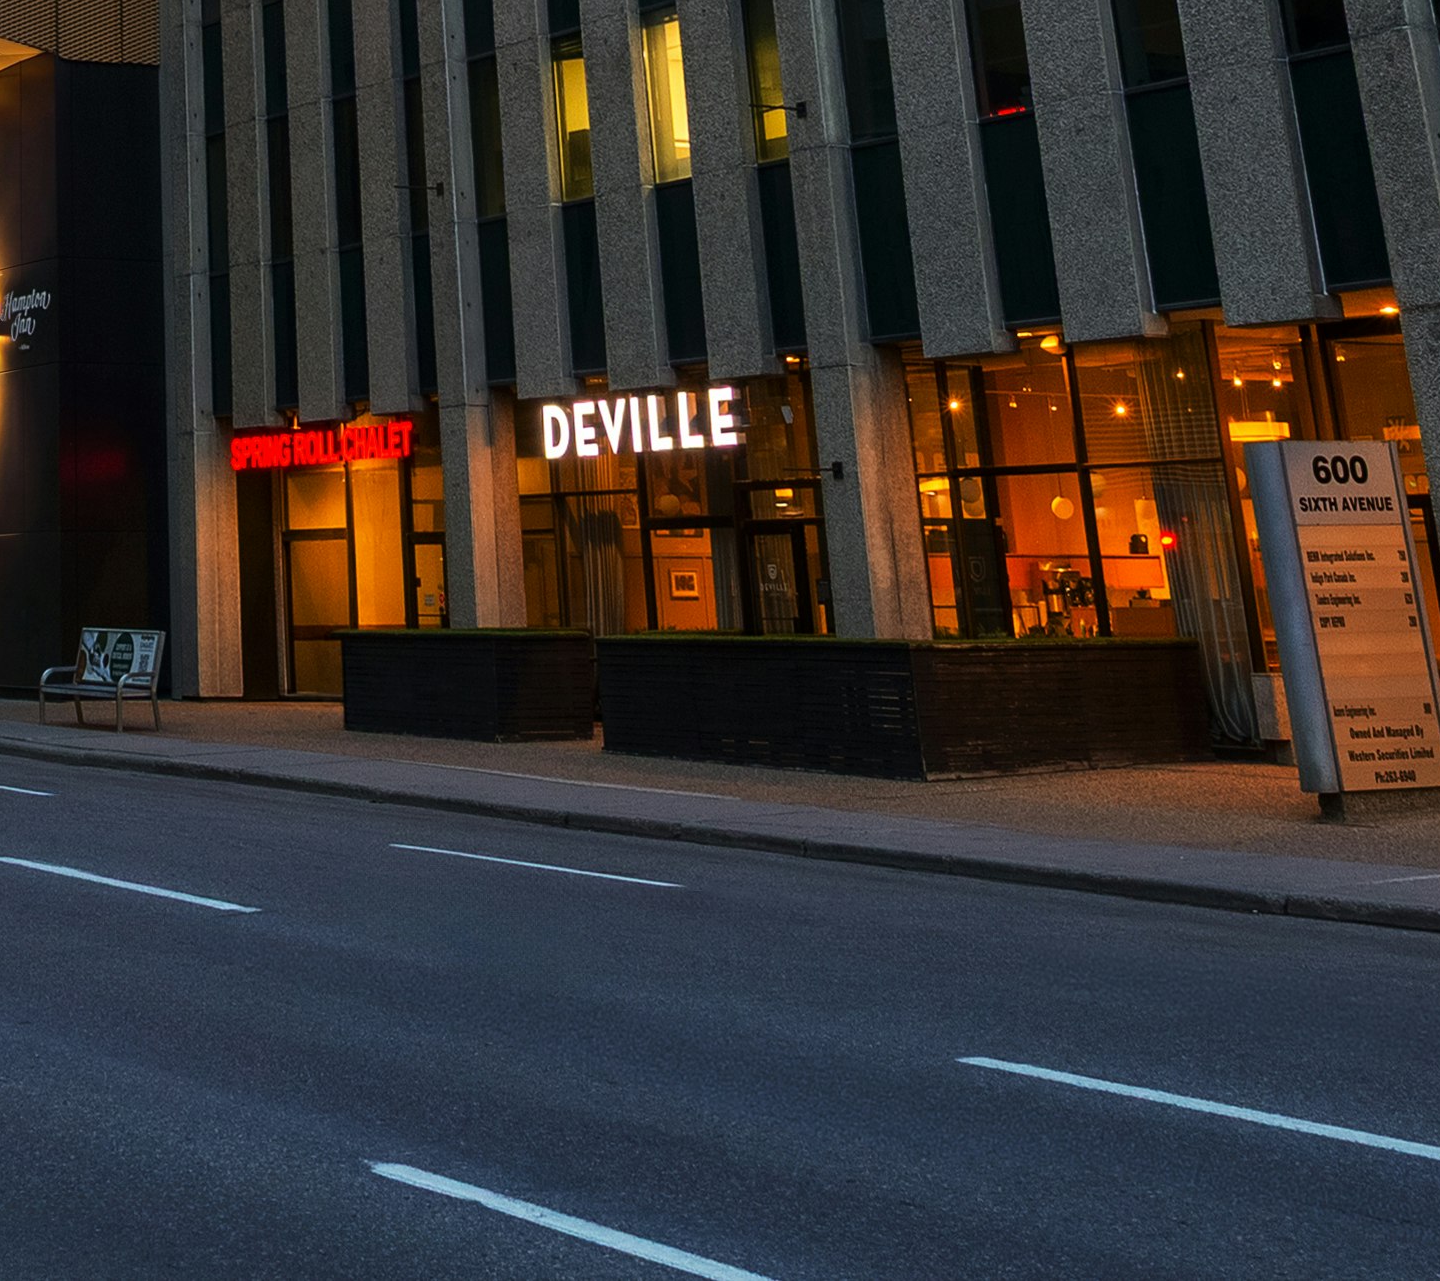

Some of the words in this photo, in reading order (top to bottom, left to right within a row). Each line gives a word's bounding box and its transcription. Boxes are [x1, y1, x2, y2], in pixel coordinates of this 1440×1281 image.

[0, 288, 51, 321] Hampton
[542, 386, 738, 460] DEVILLE
[230, 433, 291, 471] SPRING
[292, 430, 340, 465] ROLL
[341, 421, 413, 462] CHALET
[1312, 455, 1368, 484] 600
[1299, 496, 1338, 512] SIXTH
[1342, 496, 1393, 512] AVENUE
[1349, 727, 1371, 739] Owned
[1372, 726, 1385, 738] And
[1385, 725, 1414, 739] Managed
[1348, 750, 1376, 762] Western
[1376, 748, 1409, 760] Securities
[1410, 746, 1434, 759] Limited
